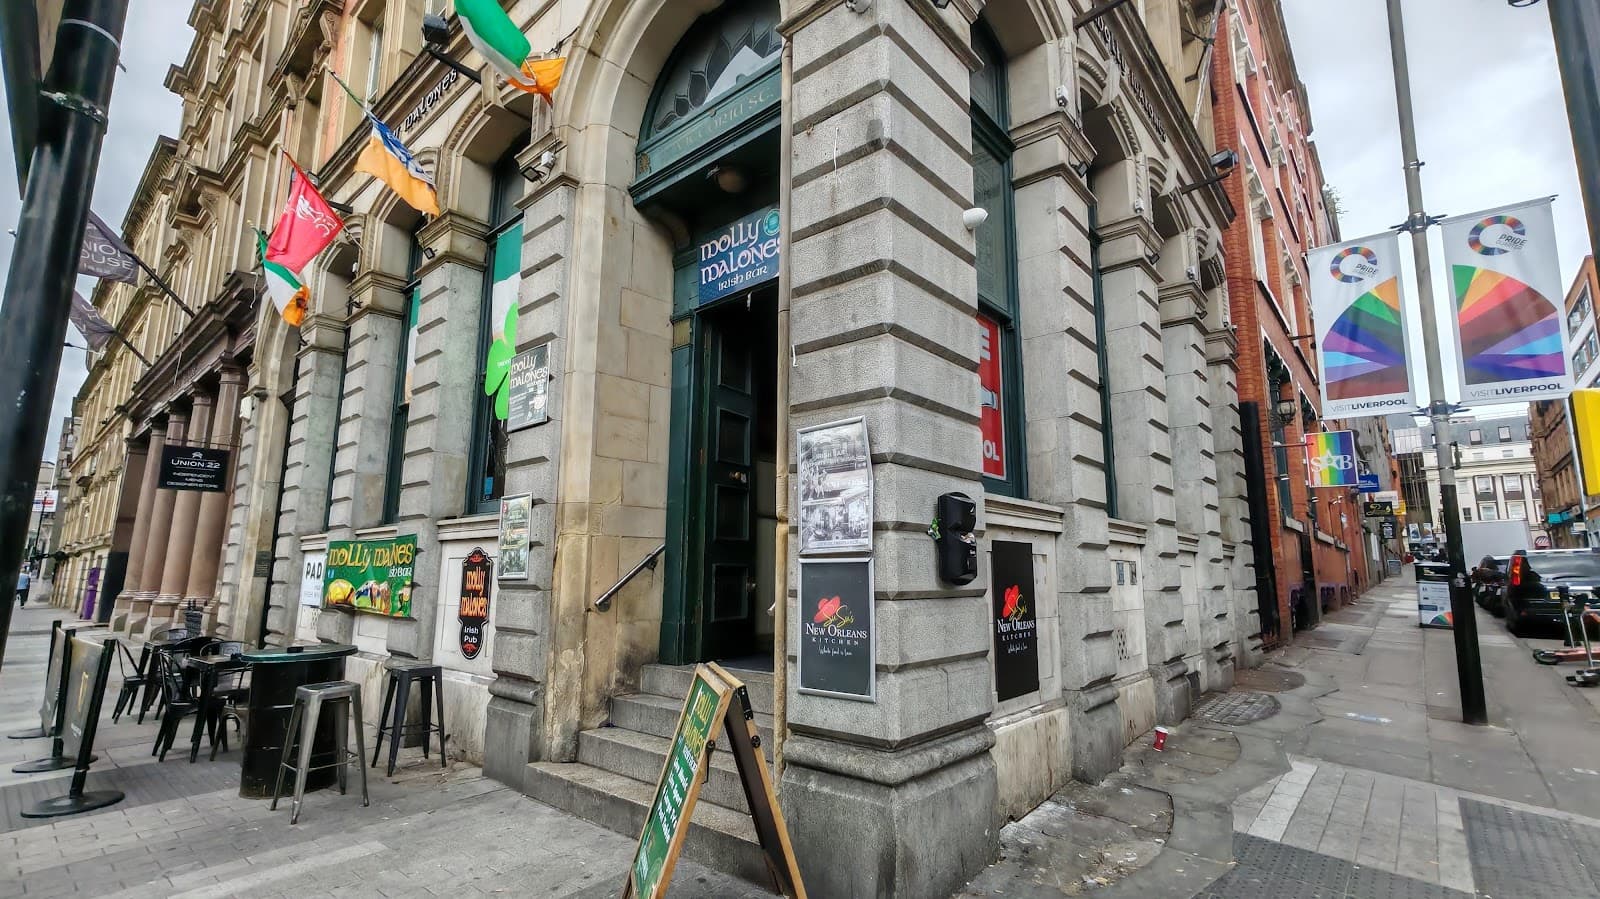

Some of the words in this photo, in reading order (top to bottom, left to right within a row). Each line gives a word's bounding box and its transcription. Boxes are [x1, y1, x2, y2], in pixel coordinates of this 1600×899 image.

[1499, 234, 1528, 246] PRIDE
[171, 458, 205, 468] UNION
[464, 626, 479, 635] Irish
[464, 635, 478, 644] Pub
[1002, 631, 1031, 641] KITCHEN
[812, 637, 859, 646] KITCHEN
